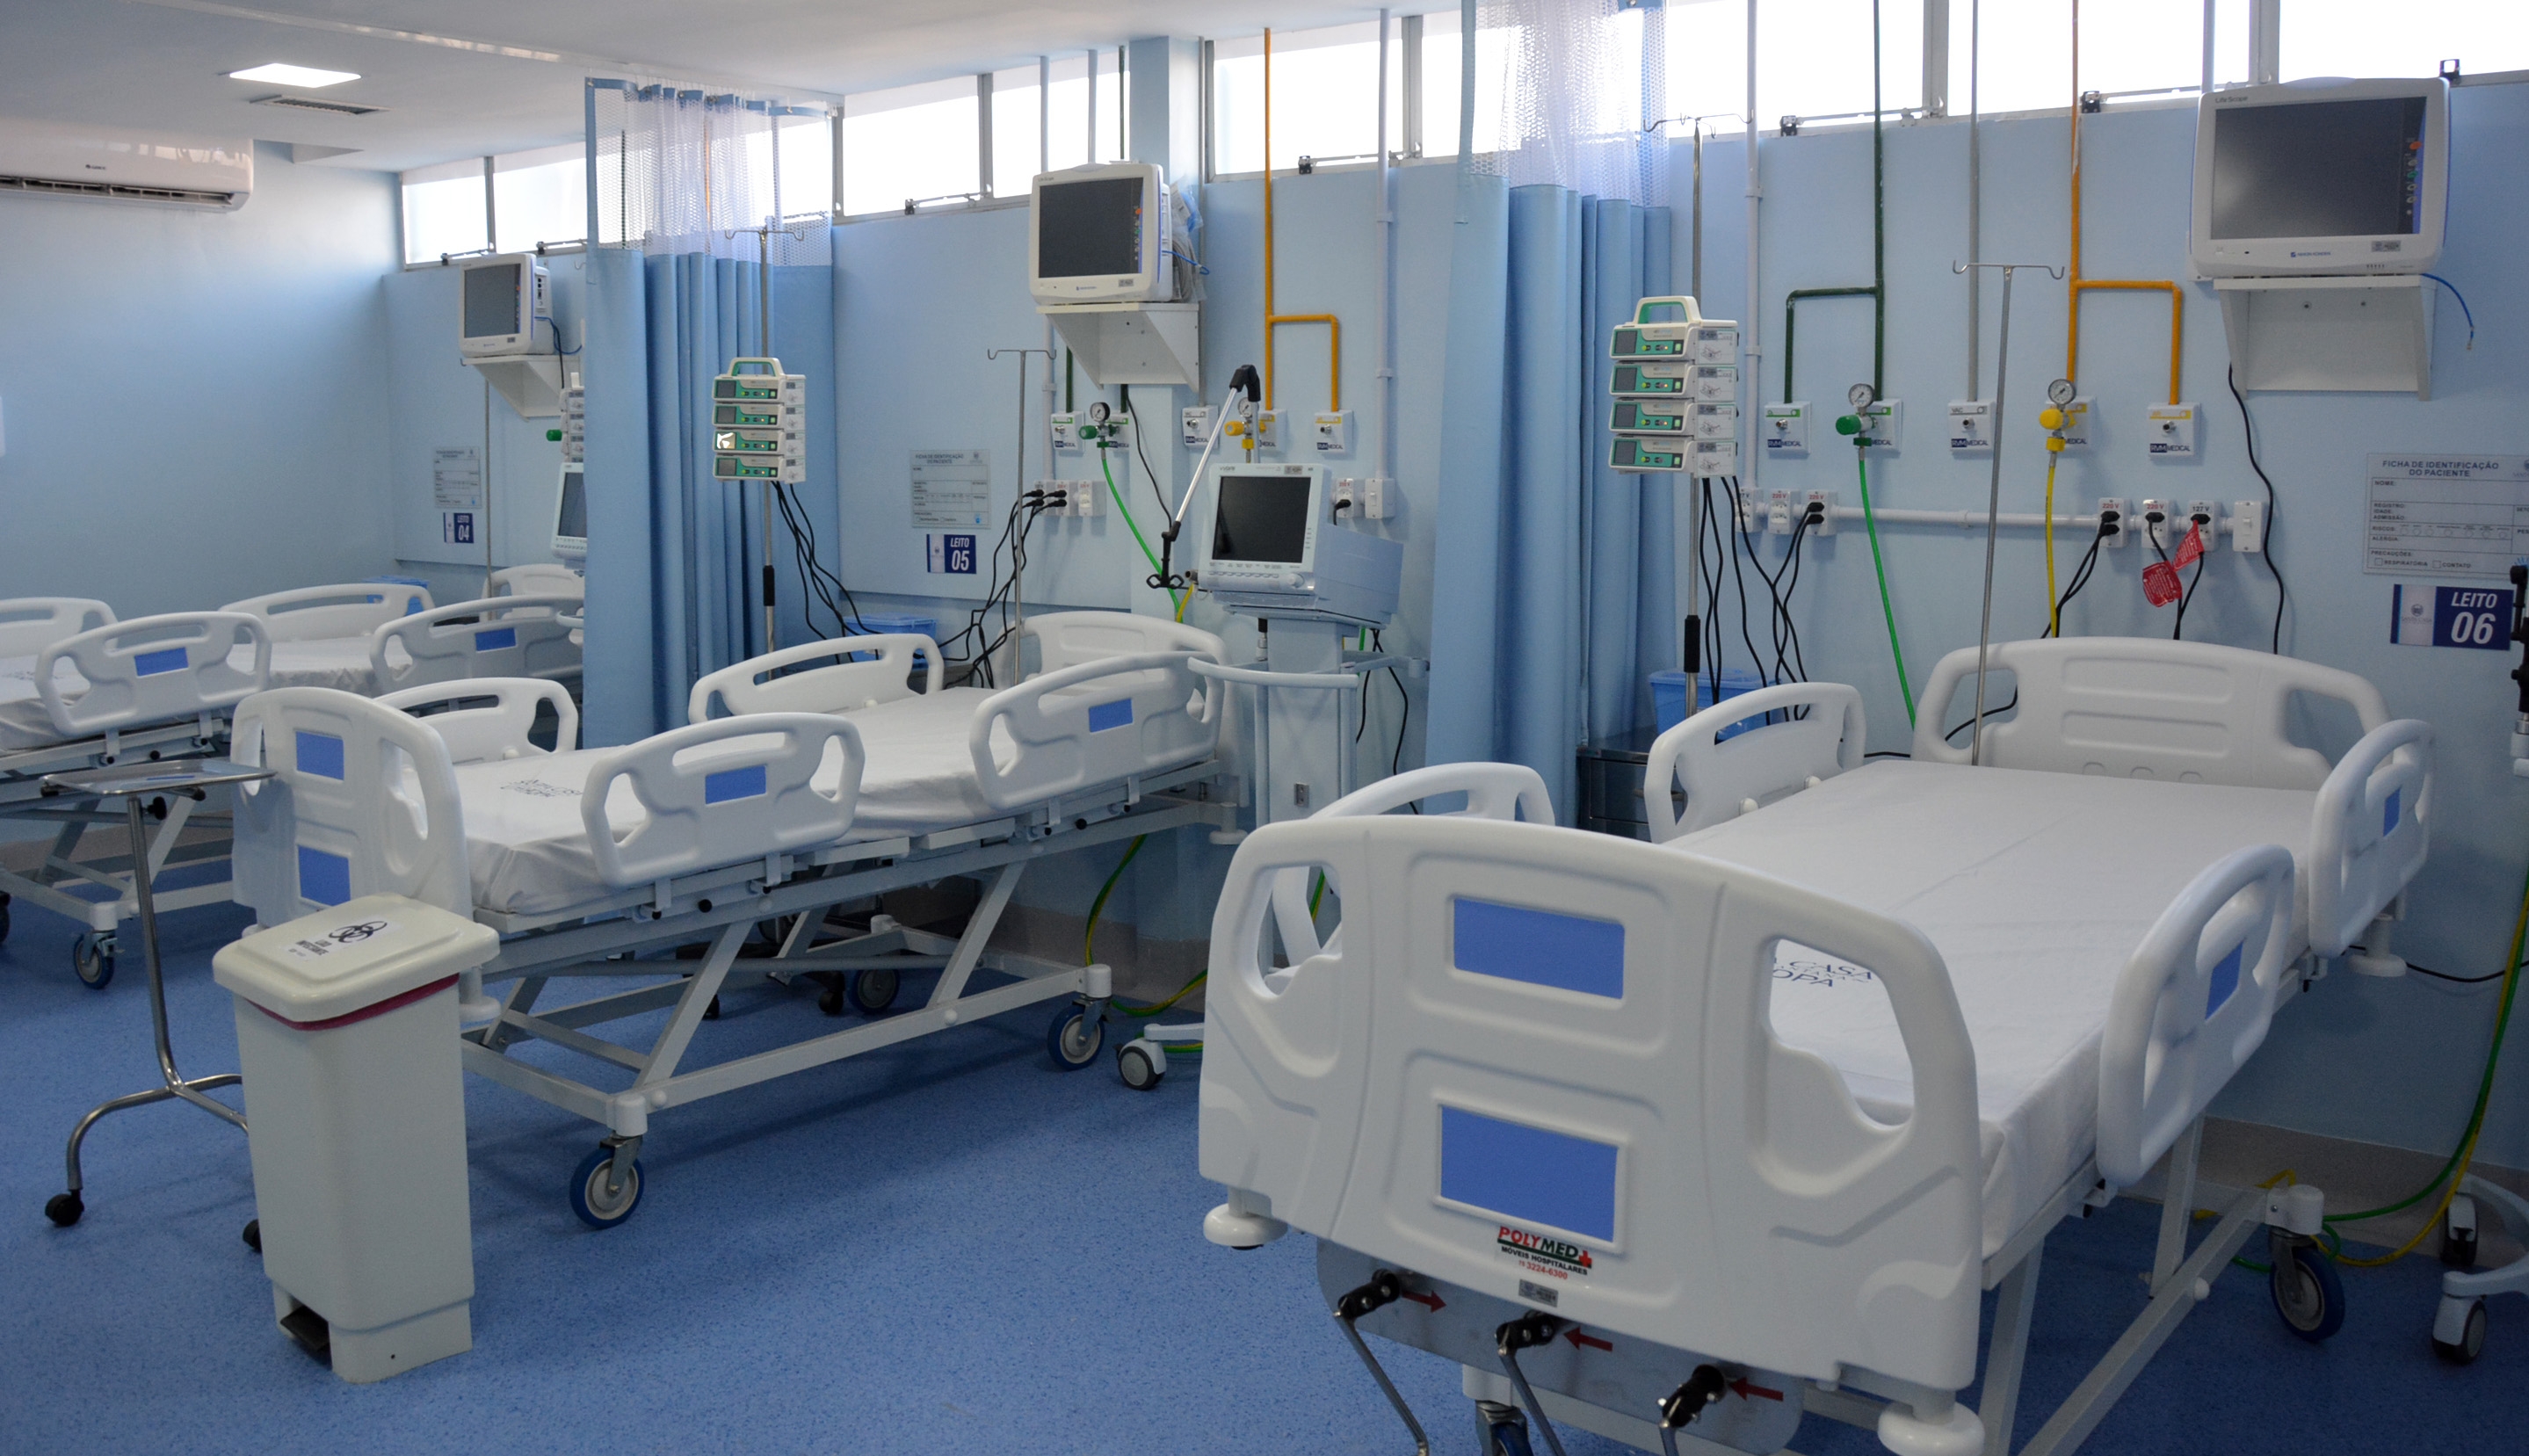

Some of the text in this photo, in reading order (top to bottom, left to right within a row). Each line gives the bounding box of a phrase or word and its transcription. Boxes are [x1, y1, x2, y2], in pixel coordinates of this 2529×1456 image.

[2426, 460, 2499, 470] IDENTIFICAÇÃO
[458, 525, 470, 541] 04
[950, 537, 970, 547] LEITO
[952, 550, 970, 571] 05
[2451, 592, 2497, 609] LEITO
[2451, 612, 2496, 644] 06
[1789, 960, 1873, 980] CASA
[1498, 1226, 1579, 1258] POLYMED
[1501, 1245, 1588, 1276] MÓVEIS HOSPITALARES
[1526, 1262, 1569, 1279] 3224-6300
